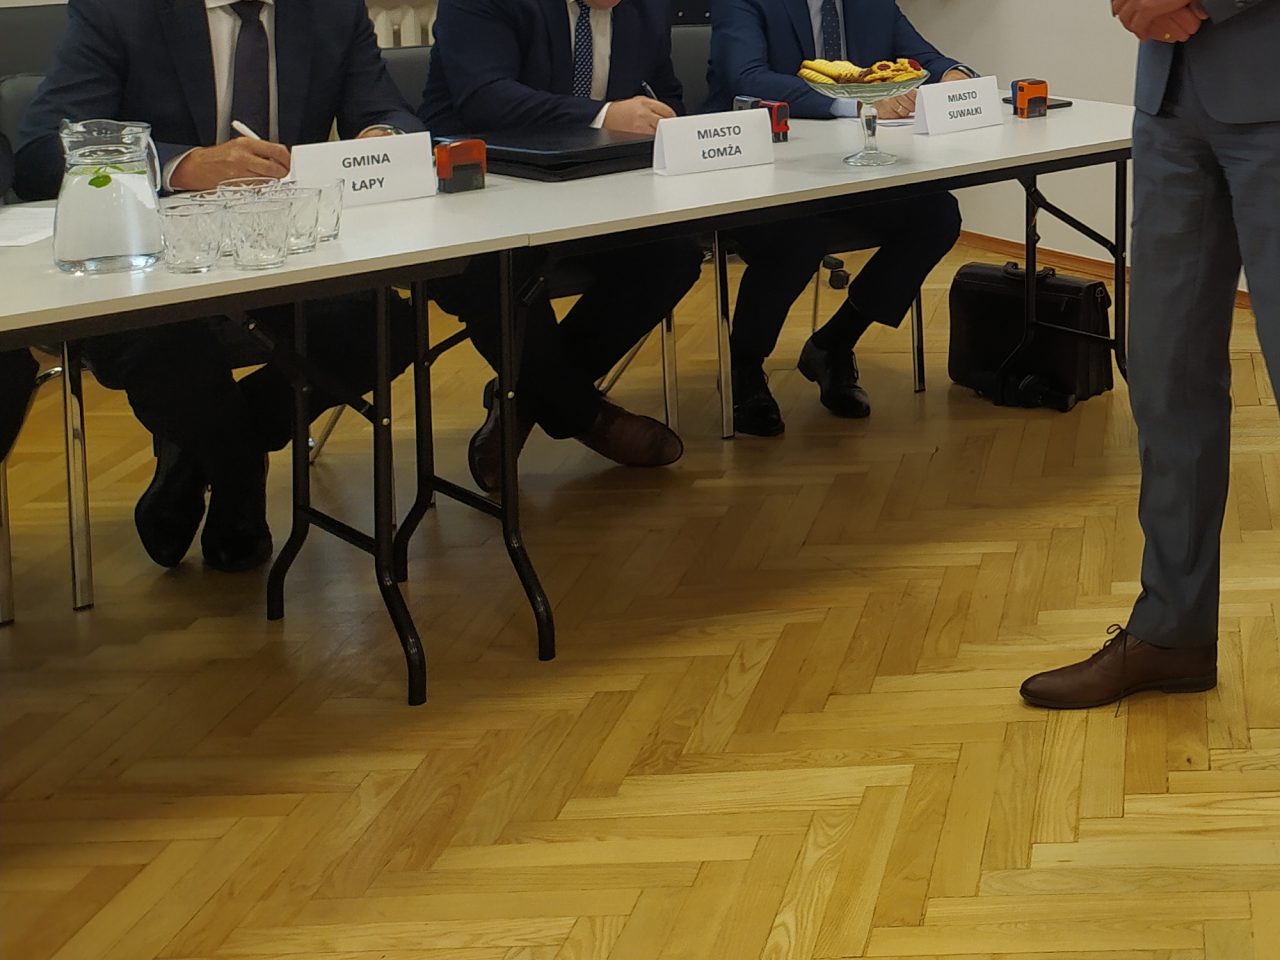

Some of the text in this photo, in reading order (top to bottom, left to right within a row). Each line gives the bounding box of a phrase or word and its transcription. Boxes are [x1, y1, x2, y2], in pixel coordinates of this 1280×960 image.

[947, 90, 978, 103] MIASTO
[948, 106, 983, 120] SUWAŁKI
[697, 125, 742, 140] MIASTO
[701, 144, 742, 159] ŁOMŻA
[341, 152, 391, 169] GMINA
[352, 177, 385, 192] ŁAPY
